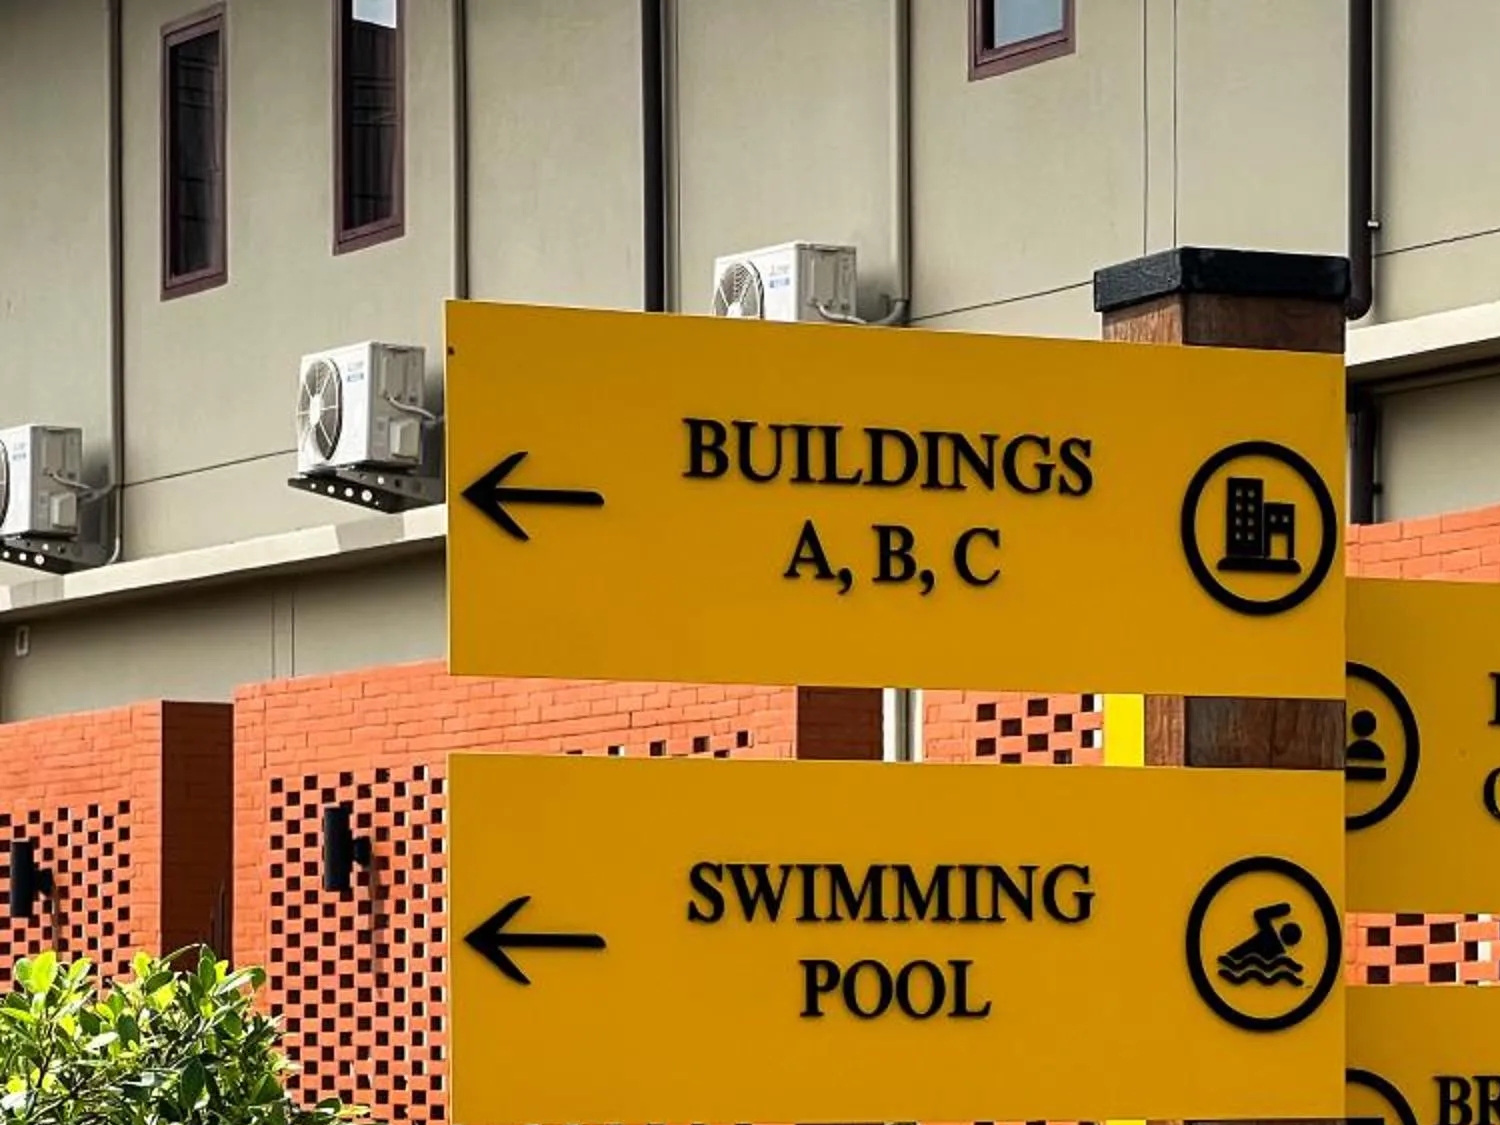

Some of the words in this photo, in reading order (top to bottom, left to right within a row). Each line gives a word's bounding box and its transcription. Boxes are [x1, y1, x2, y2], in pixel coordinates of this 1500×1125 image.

[683, 418, 1093, 497] BUILDINGS
[784, 520, 853, 594] A,
[872, 525, 934, 595] B,
[953, 527, 1000, 587] C
[687, 862, 1095, 924] SWIMMING
[799, 960, 991, 1020] POOL
